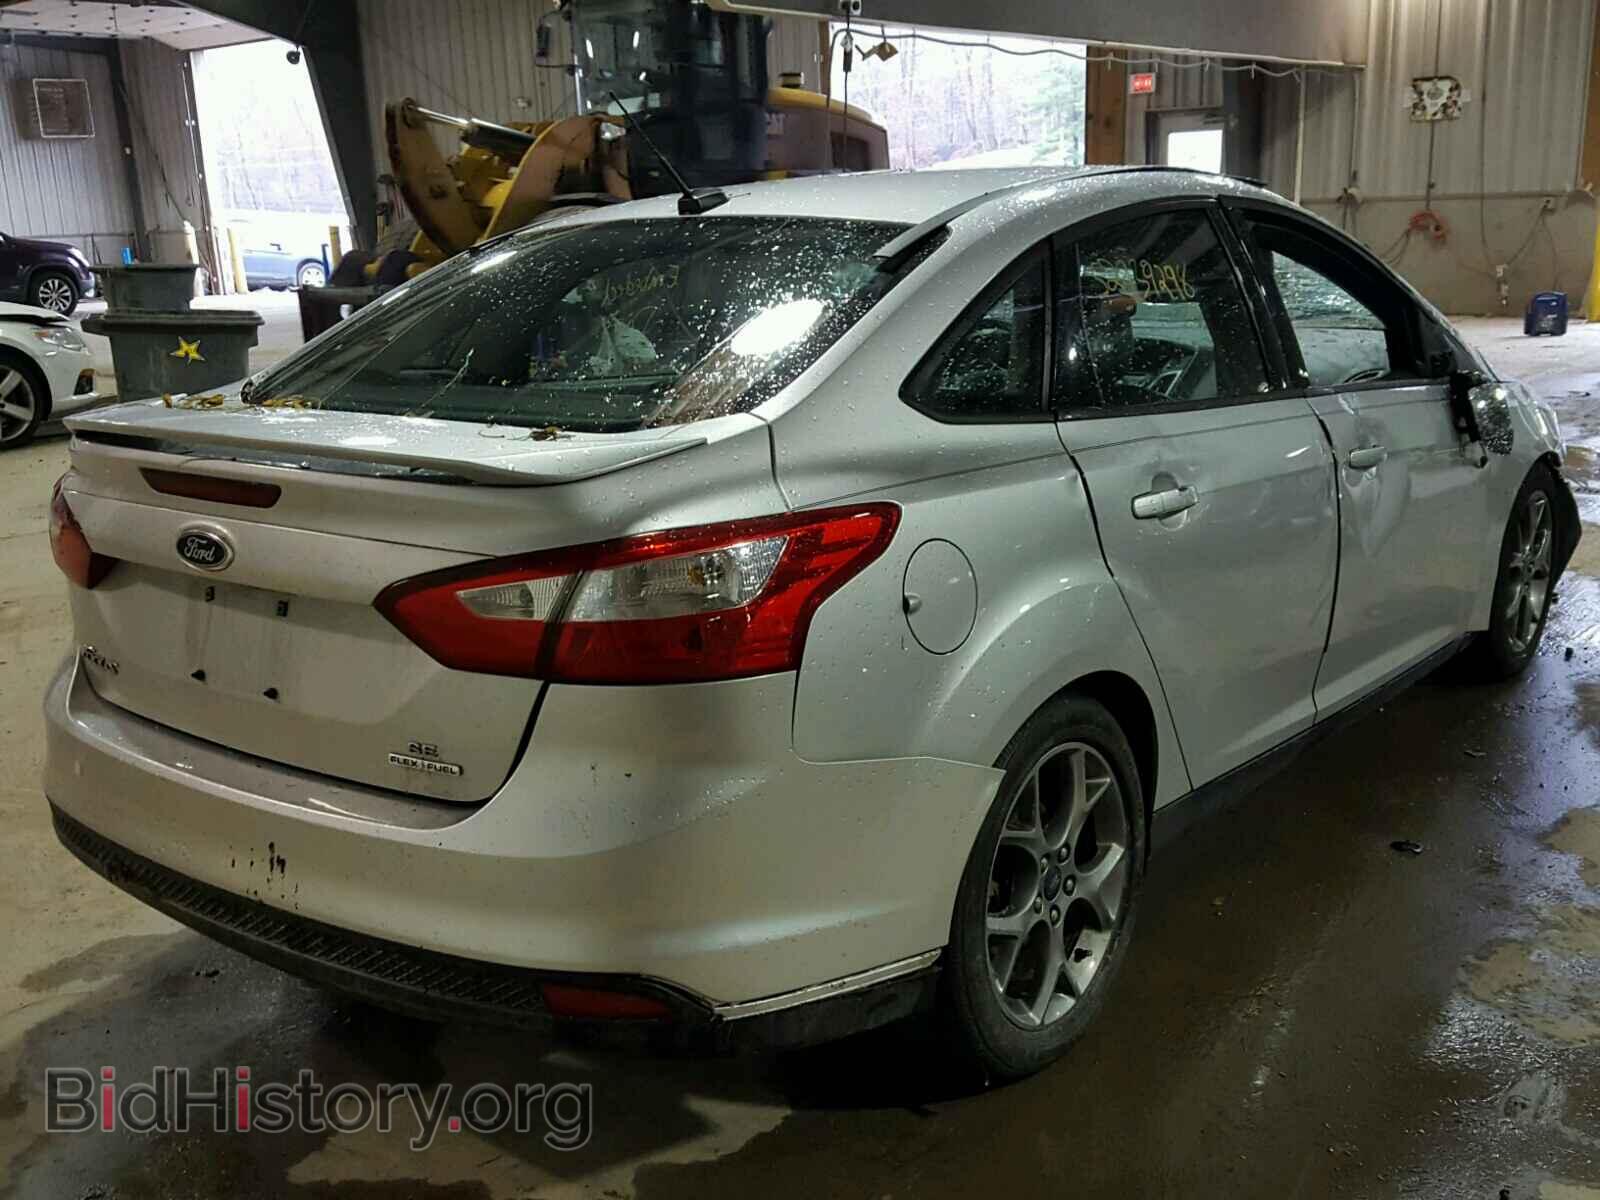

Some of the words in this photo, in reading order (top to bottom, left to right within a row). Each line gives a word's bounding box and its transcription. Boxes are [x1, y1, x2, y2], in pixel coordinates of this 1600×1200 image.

[184, 536, 216, 562] Ford
[389, 755, 418, 768] FLEX
[427, 762, 458, 775] FUEL
